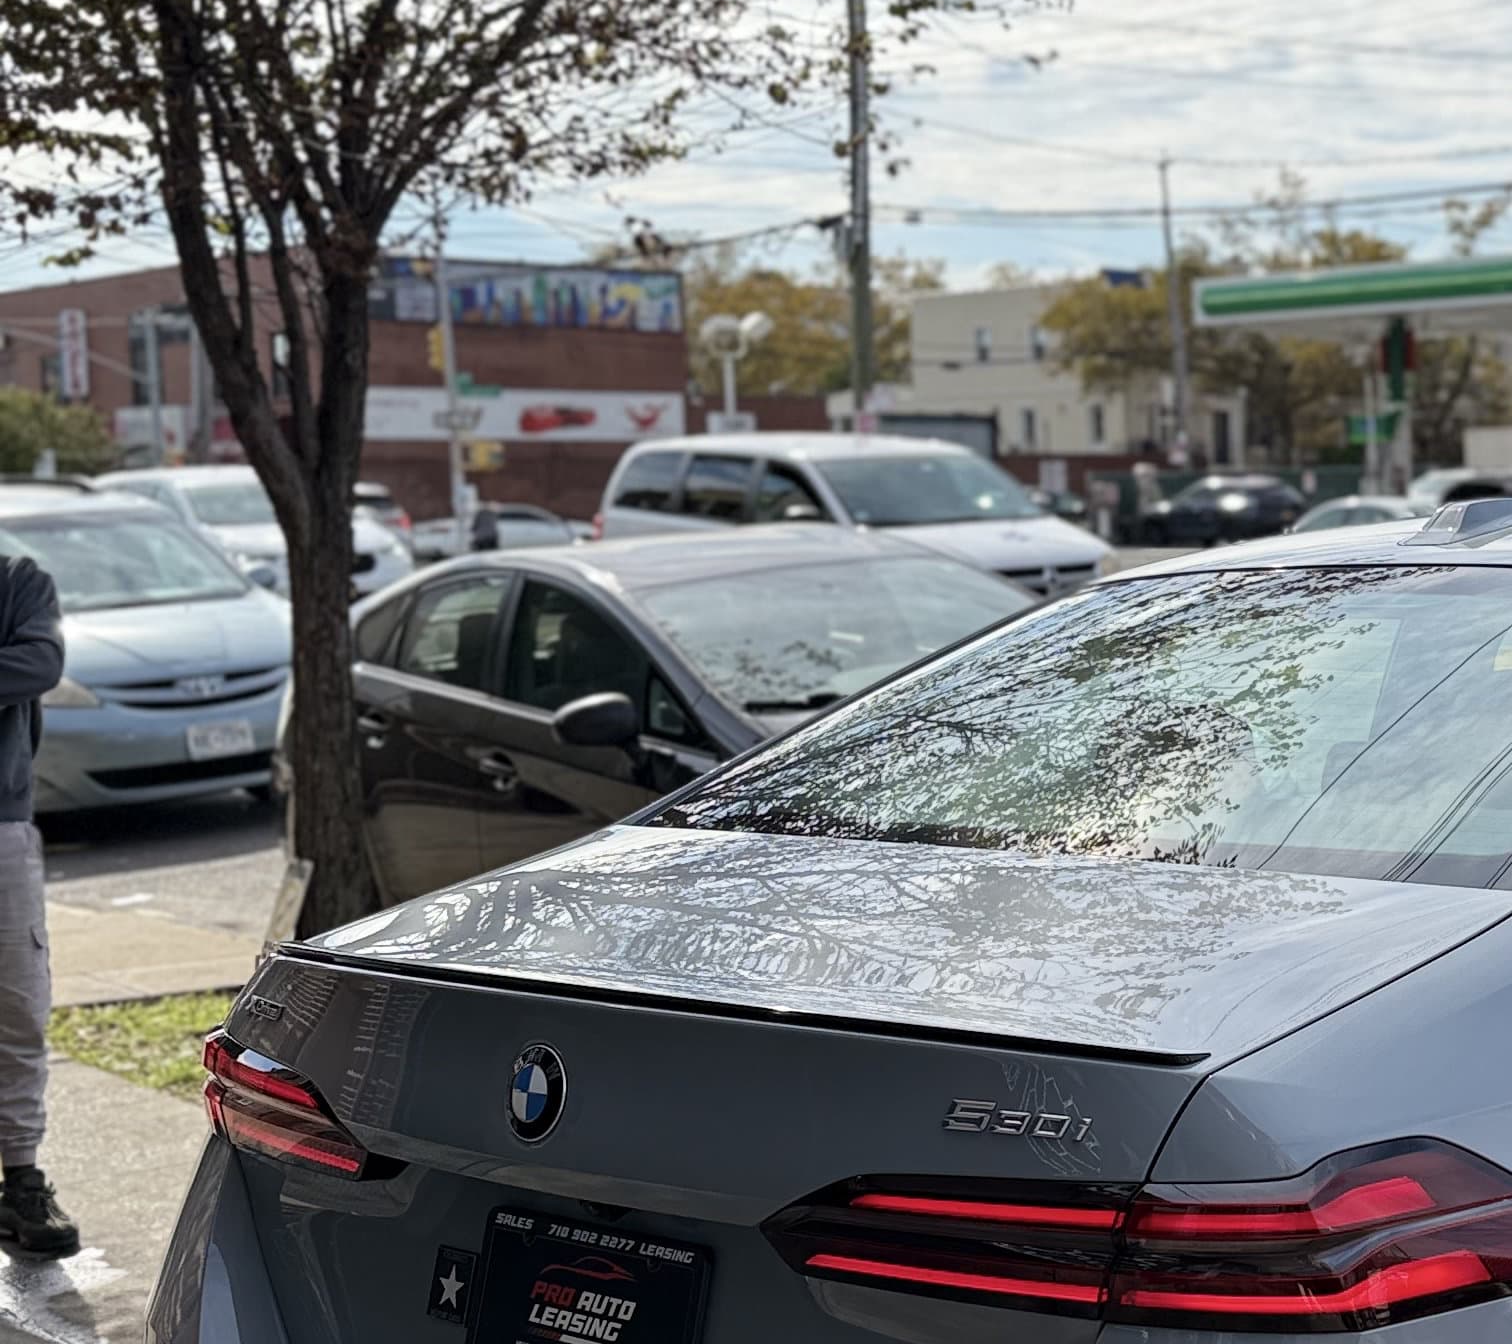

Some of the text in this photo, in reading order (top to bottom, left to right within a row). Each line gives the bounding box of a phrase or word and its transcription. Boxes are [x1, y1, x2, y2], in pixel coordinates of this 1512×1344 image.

[942, 1098, 1094, 1142] 530i
[494, 1212, 696, 1264] SALES 718 902 2277 LEASING
[529, 1280, 637, 1321] PRO AUTO
[527, 1303, 623, 1342] LEASING
